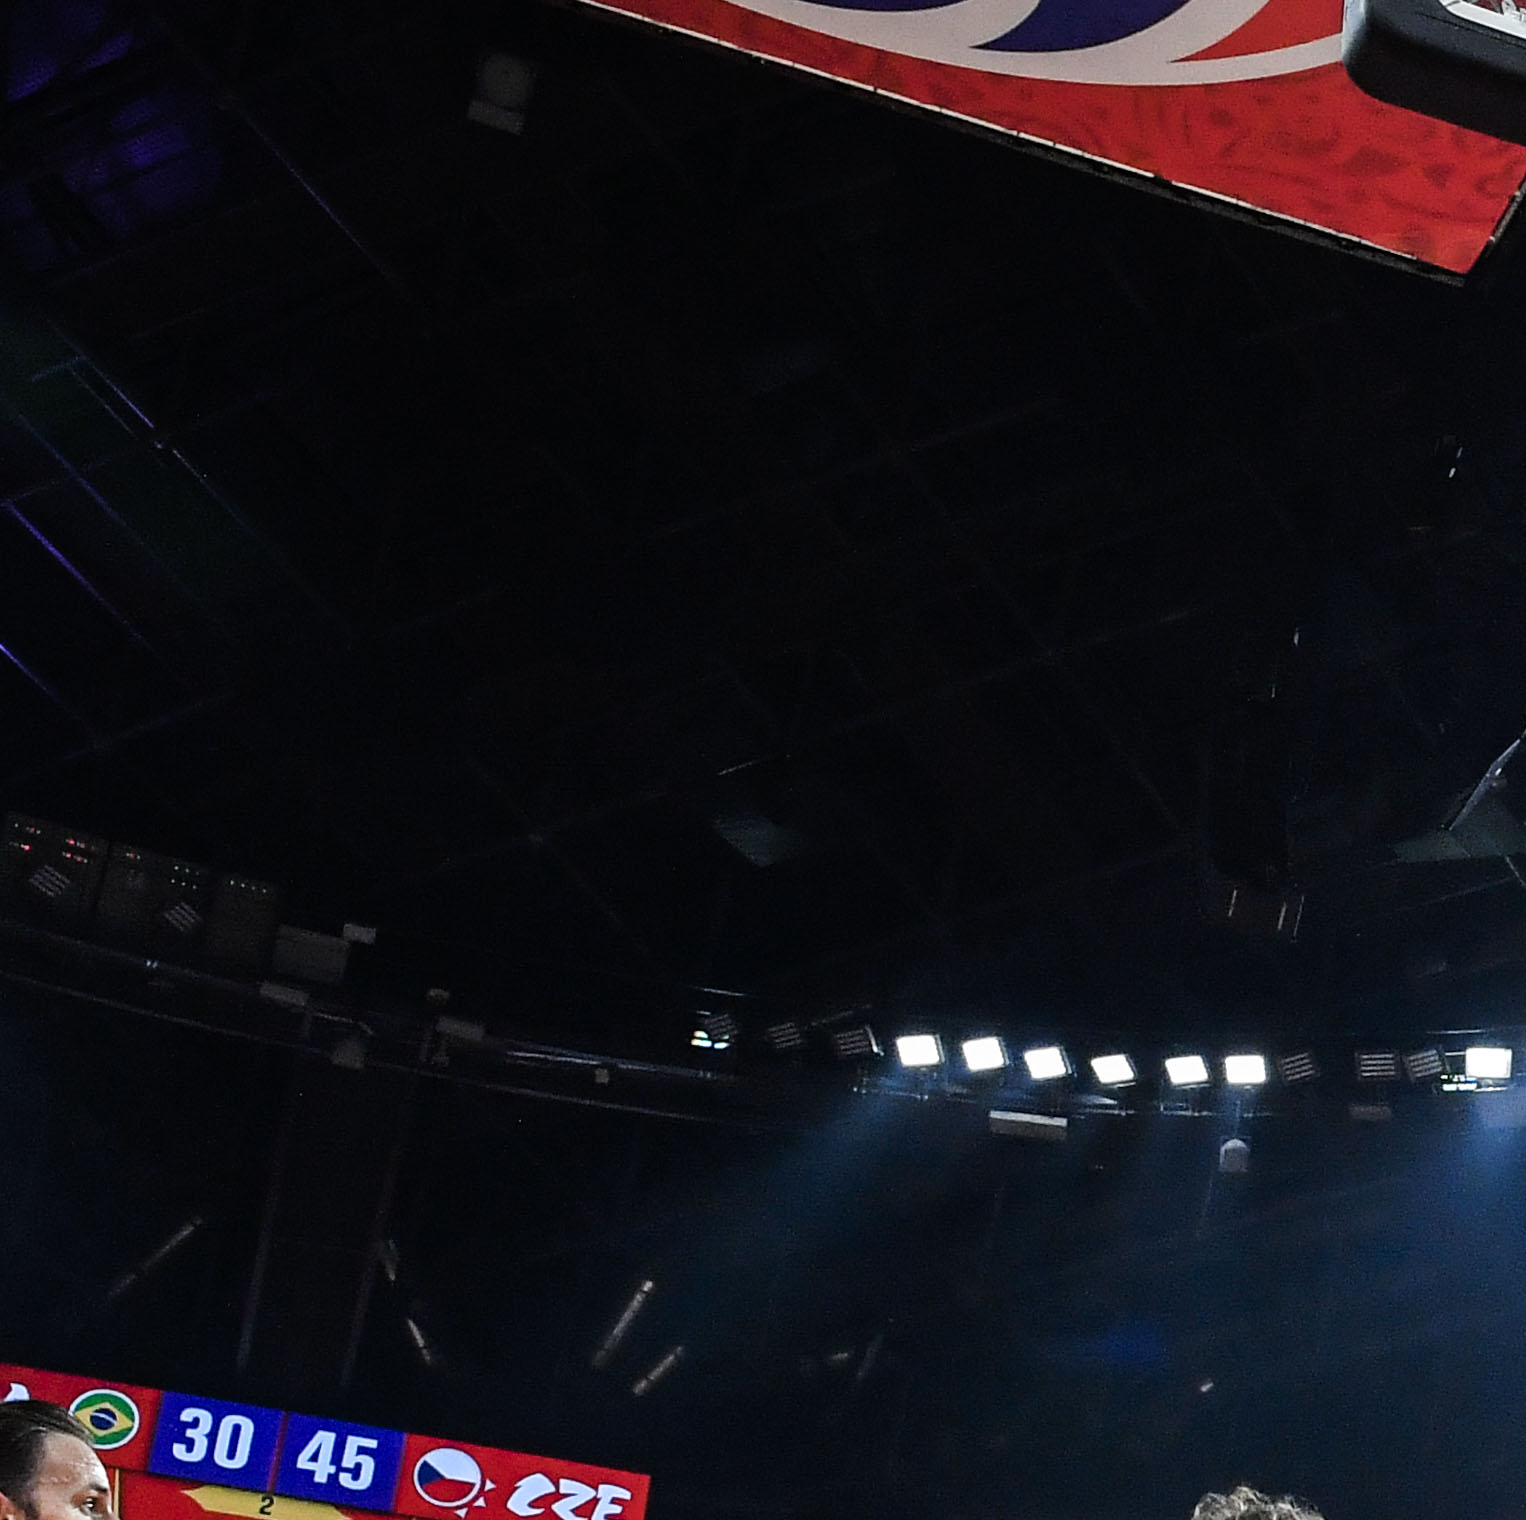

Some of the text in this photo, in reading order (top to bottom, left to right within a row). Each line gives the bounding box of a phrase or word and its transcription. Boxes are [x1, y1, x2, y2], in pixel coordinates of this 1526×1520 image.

[171, 1406, 256, 1470] 30
[296, 1429, 379, 1492] 45
[259, 1496, 275, 1516] 2
